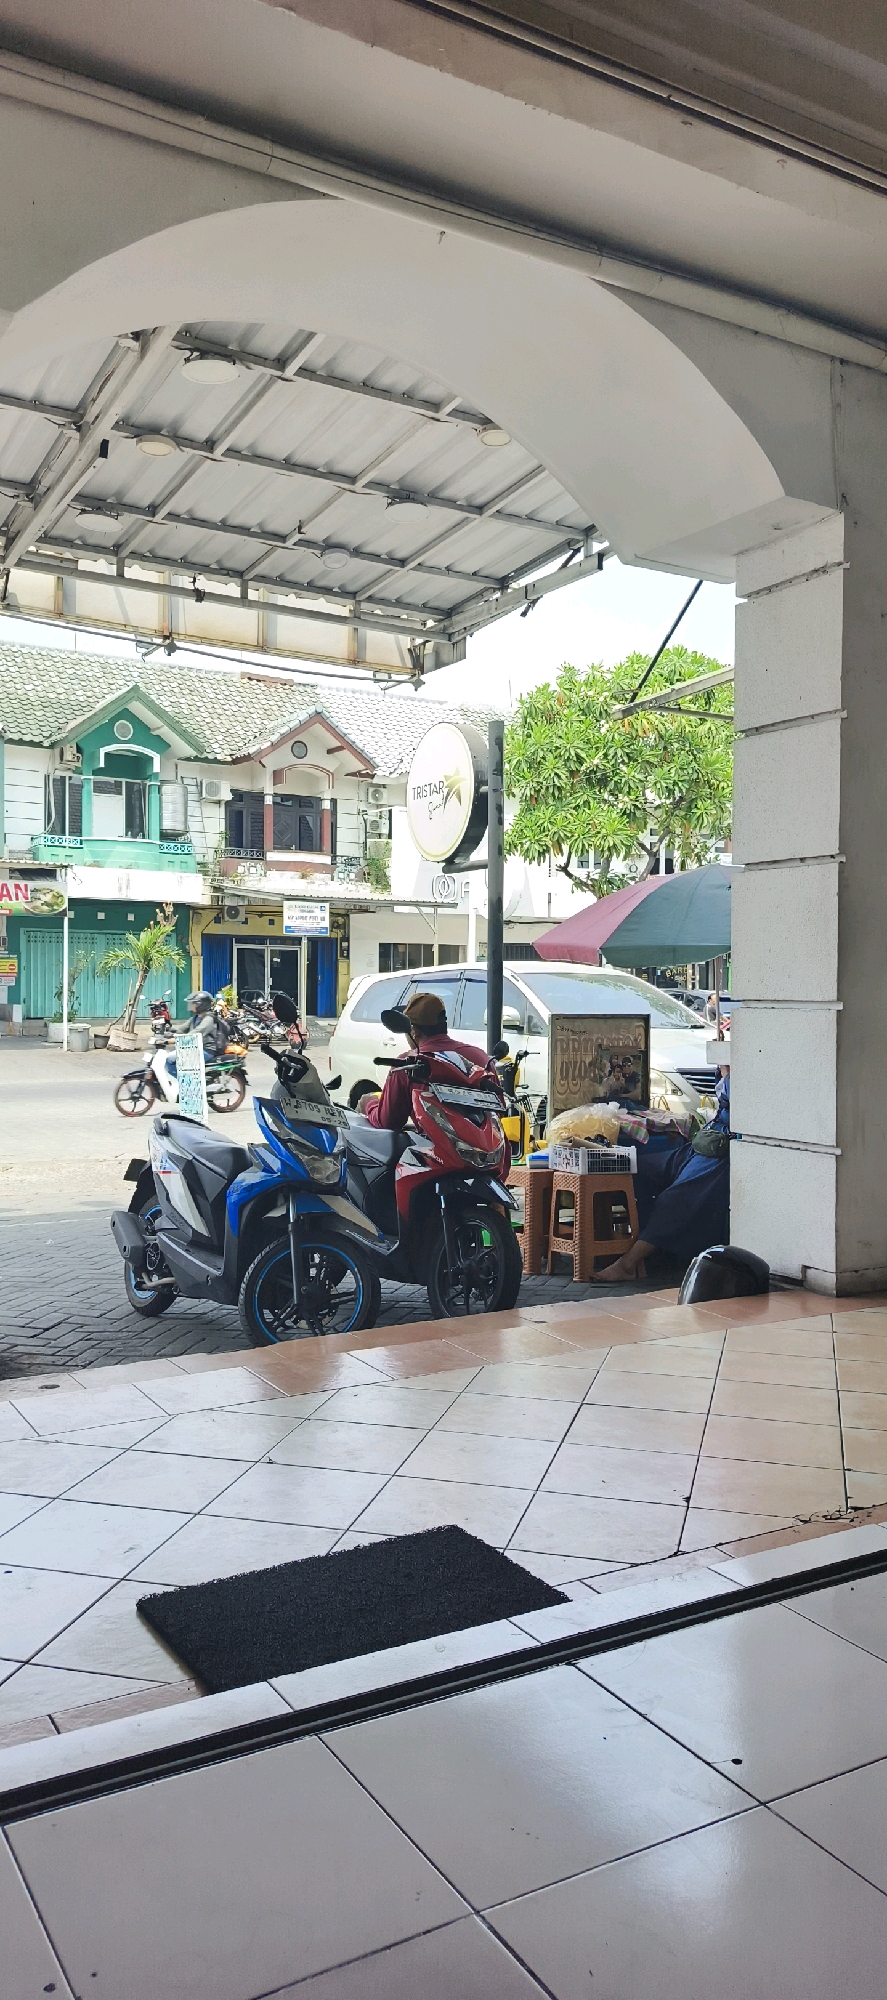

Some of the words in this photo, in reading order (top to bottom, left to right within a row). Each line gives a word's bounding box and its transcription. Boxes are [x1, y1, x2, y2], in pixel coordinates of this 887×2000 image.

[412, 781, 445, 800] TRISTAR
[0, 883, 29, 901] AN
[283, 1097, 292, 1107] W
